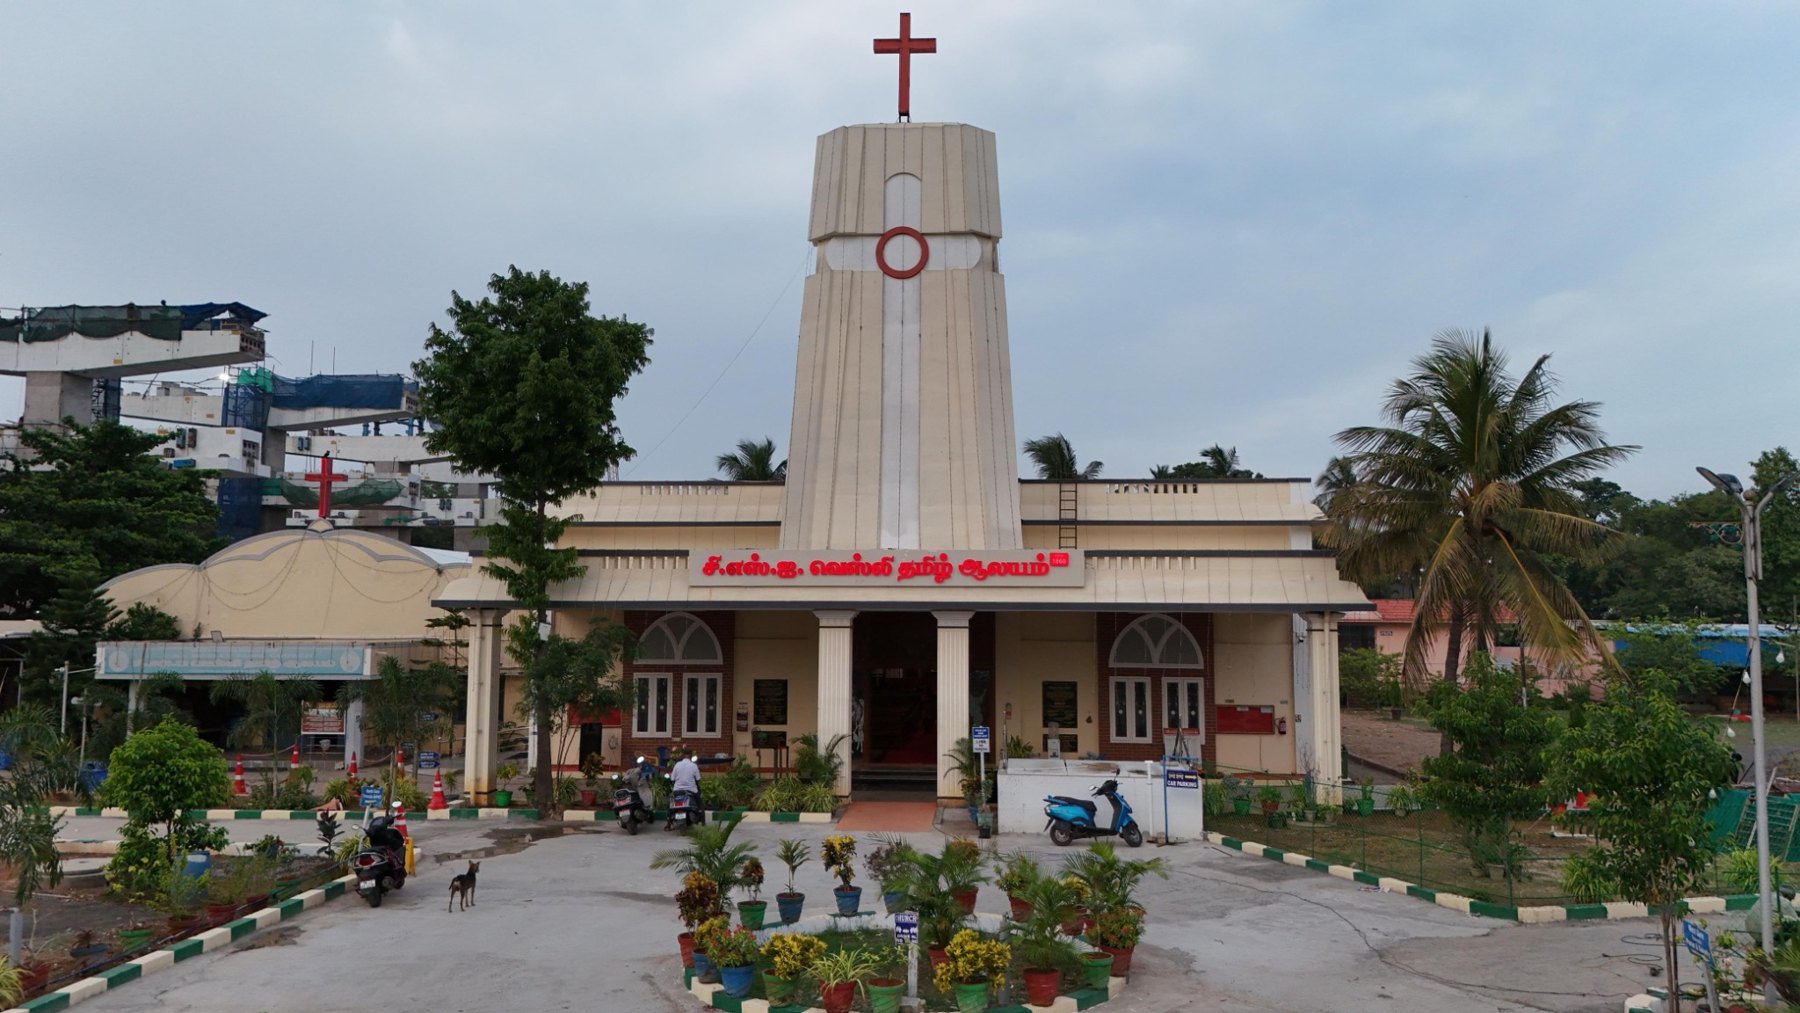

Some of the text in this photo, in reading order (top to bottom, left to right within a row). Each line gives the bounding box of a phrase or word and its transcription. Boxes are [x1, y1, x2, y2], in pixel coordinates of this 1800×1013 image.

[809, 553, 895, 577] வெஸ்லி
[897, 553, 953, 584] தமிழ்
[958, 553, 1050, 581] ஆலயம்
